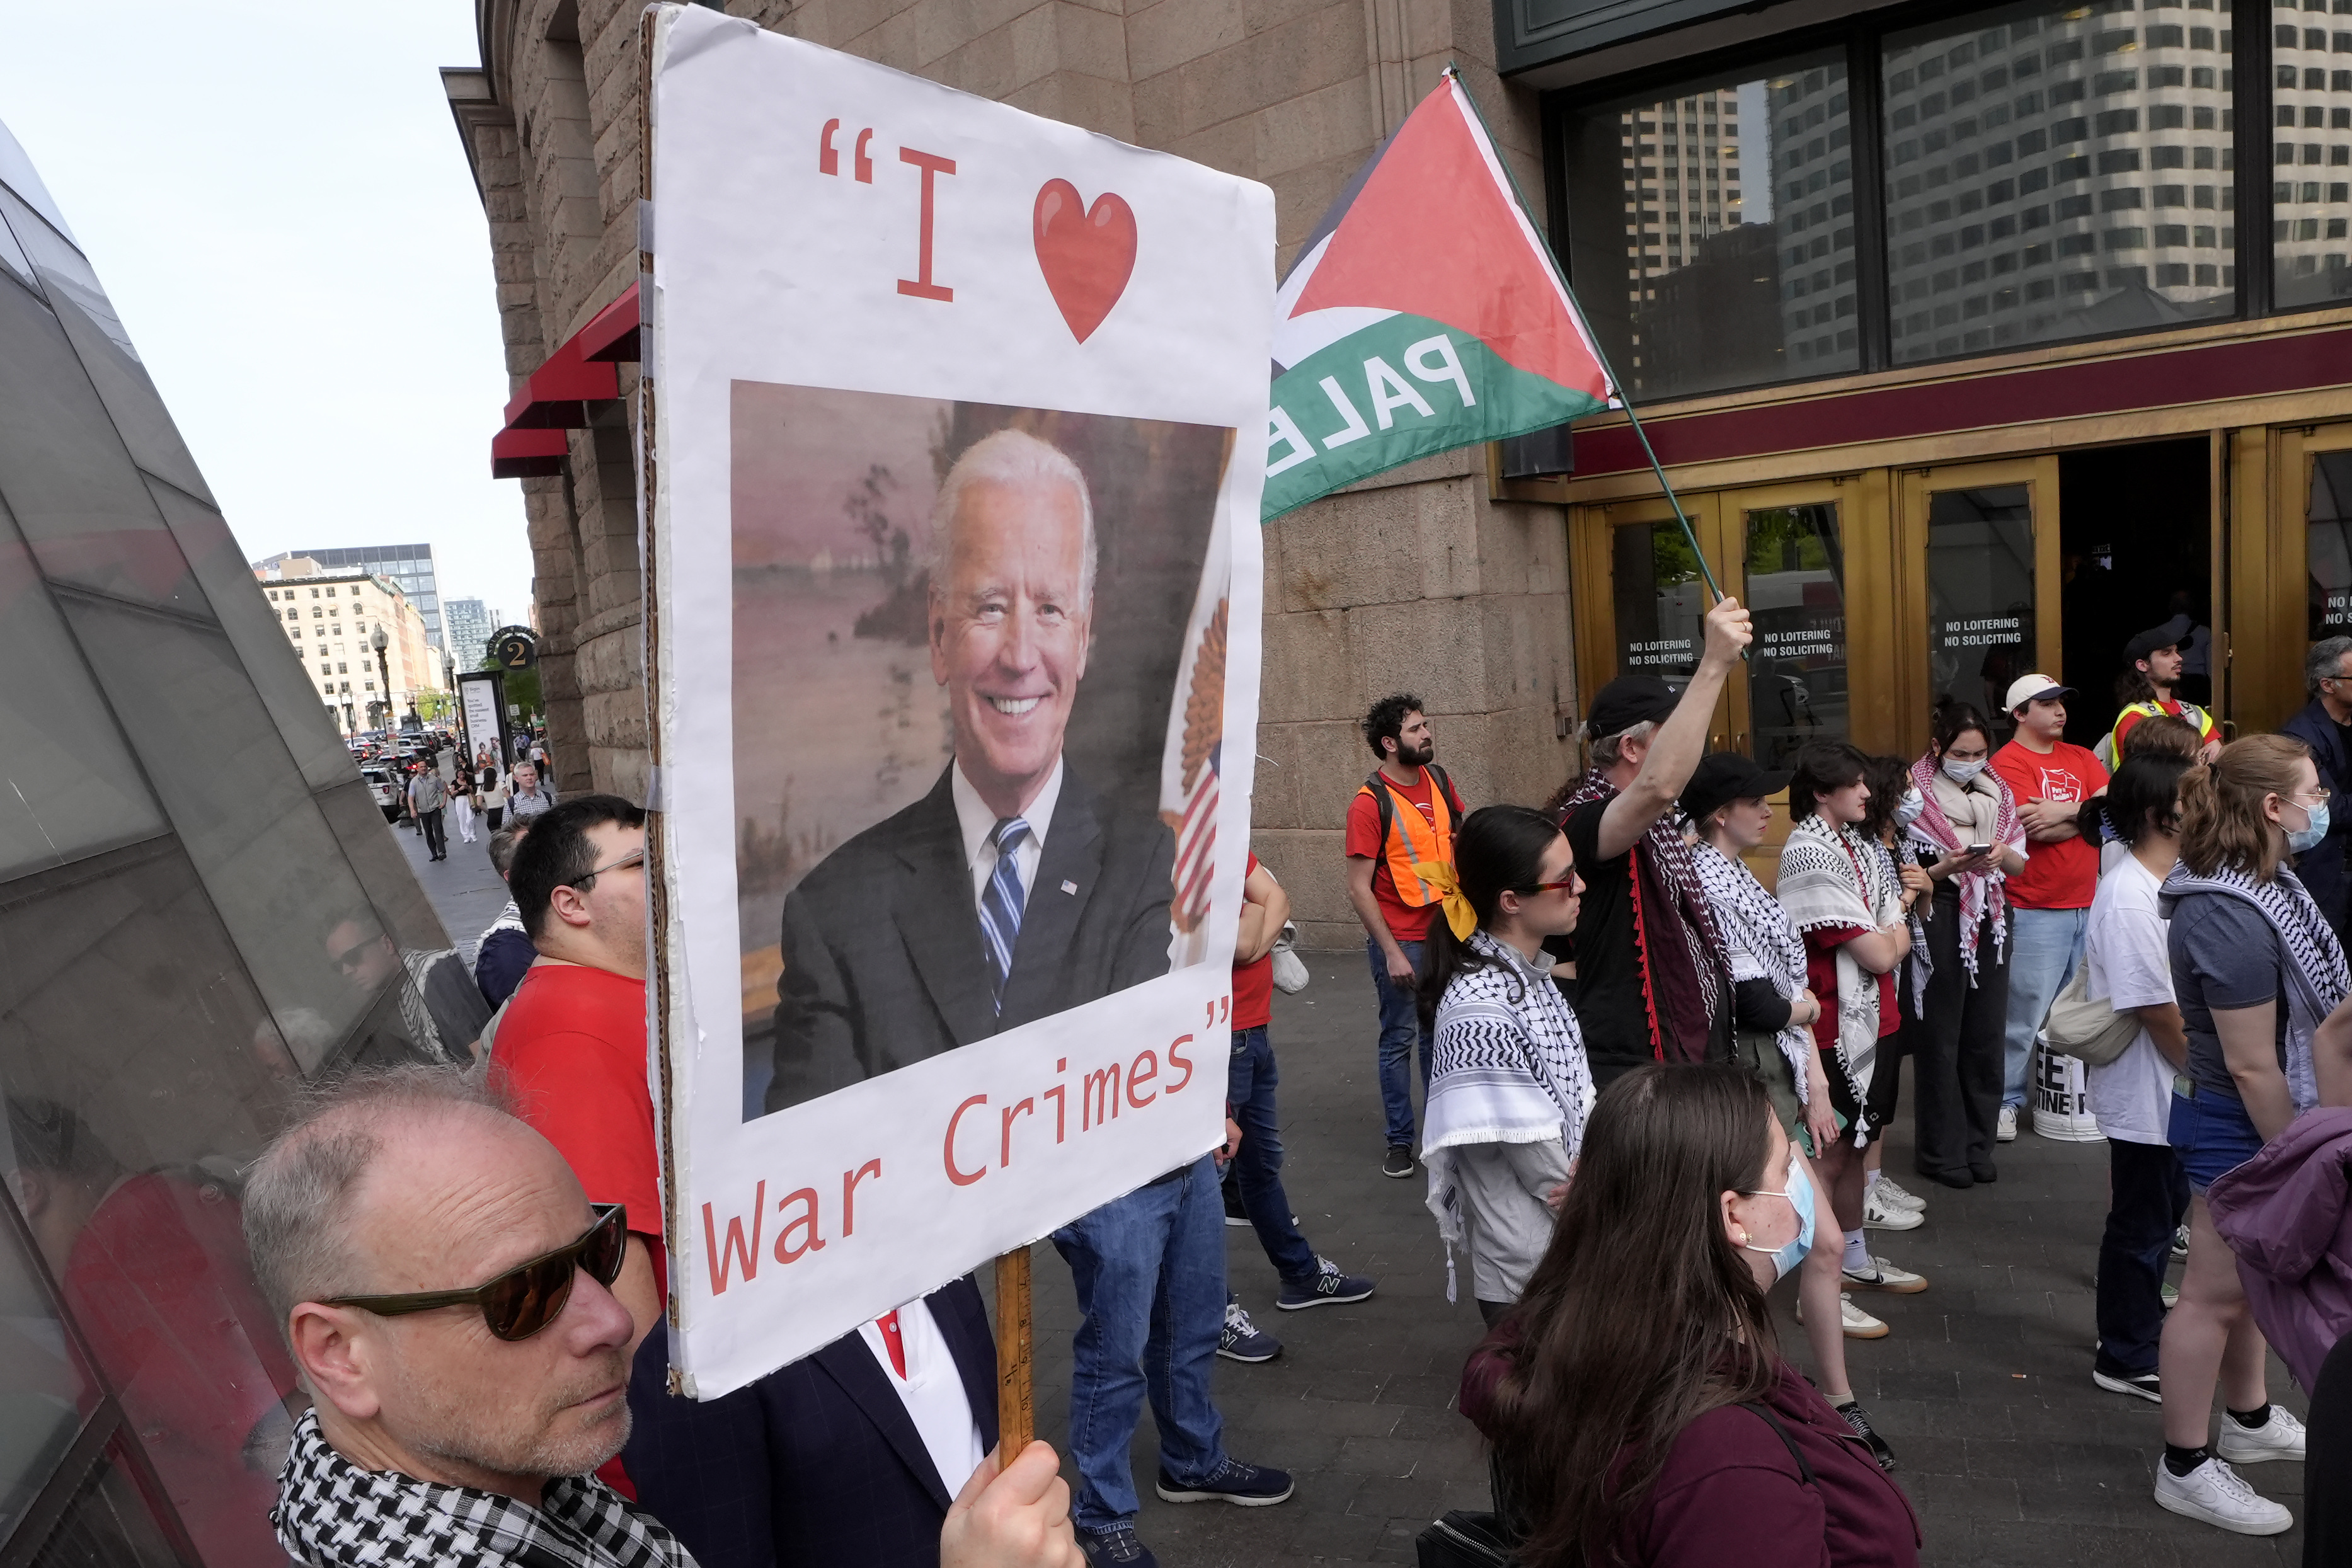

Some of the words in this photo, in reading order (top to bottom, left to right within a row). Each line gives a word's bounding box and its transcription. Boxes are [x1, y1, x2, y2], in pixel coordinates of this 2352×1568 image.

[2327, 596, 2345, 609] NO
[1946, 621, 1961, 632] NO
[1964, 617, 2019, 631] LOITERING
[2325, 612, 2343, 624] NO
[1765, 632, 1778, 643] NO
[1781, 629, 1831, 642] LOITERING
[1944, 636, 1959, 647] NO
[1962, 632, 2021, 646] SOLICITING
[1630, 642, 1643, 652] NO
[1644, 639, 1691, 651] LOITERING
[1764, 647, 1777, 657] NO
[1779, 643, 1833, 656] SOLICITING
[507, 642, 526, 666] 2
[1629, 656, 1642, 665] NO
[1644, 653, 1694, 665] SOLICITING
[702, 1158, 881, 1296] War
[944, 995, 1230, 1186] Crimes”
[1317, 1275, 1340, 1294] N
